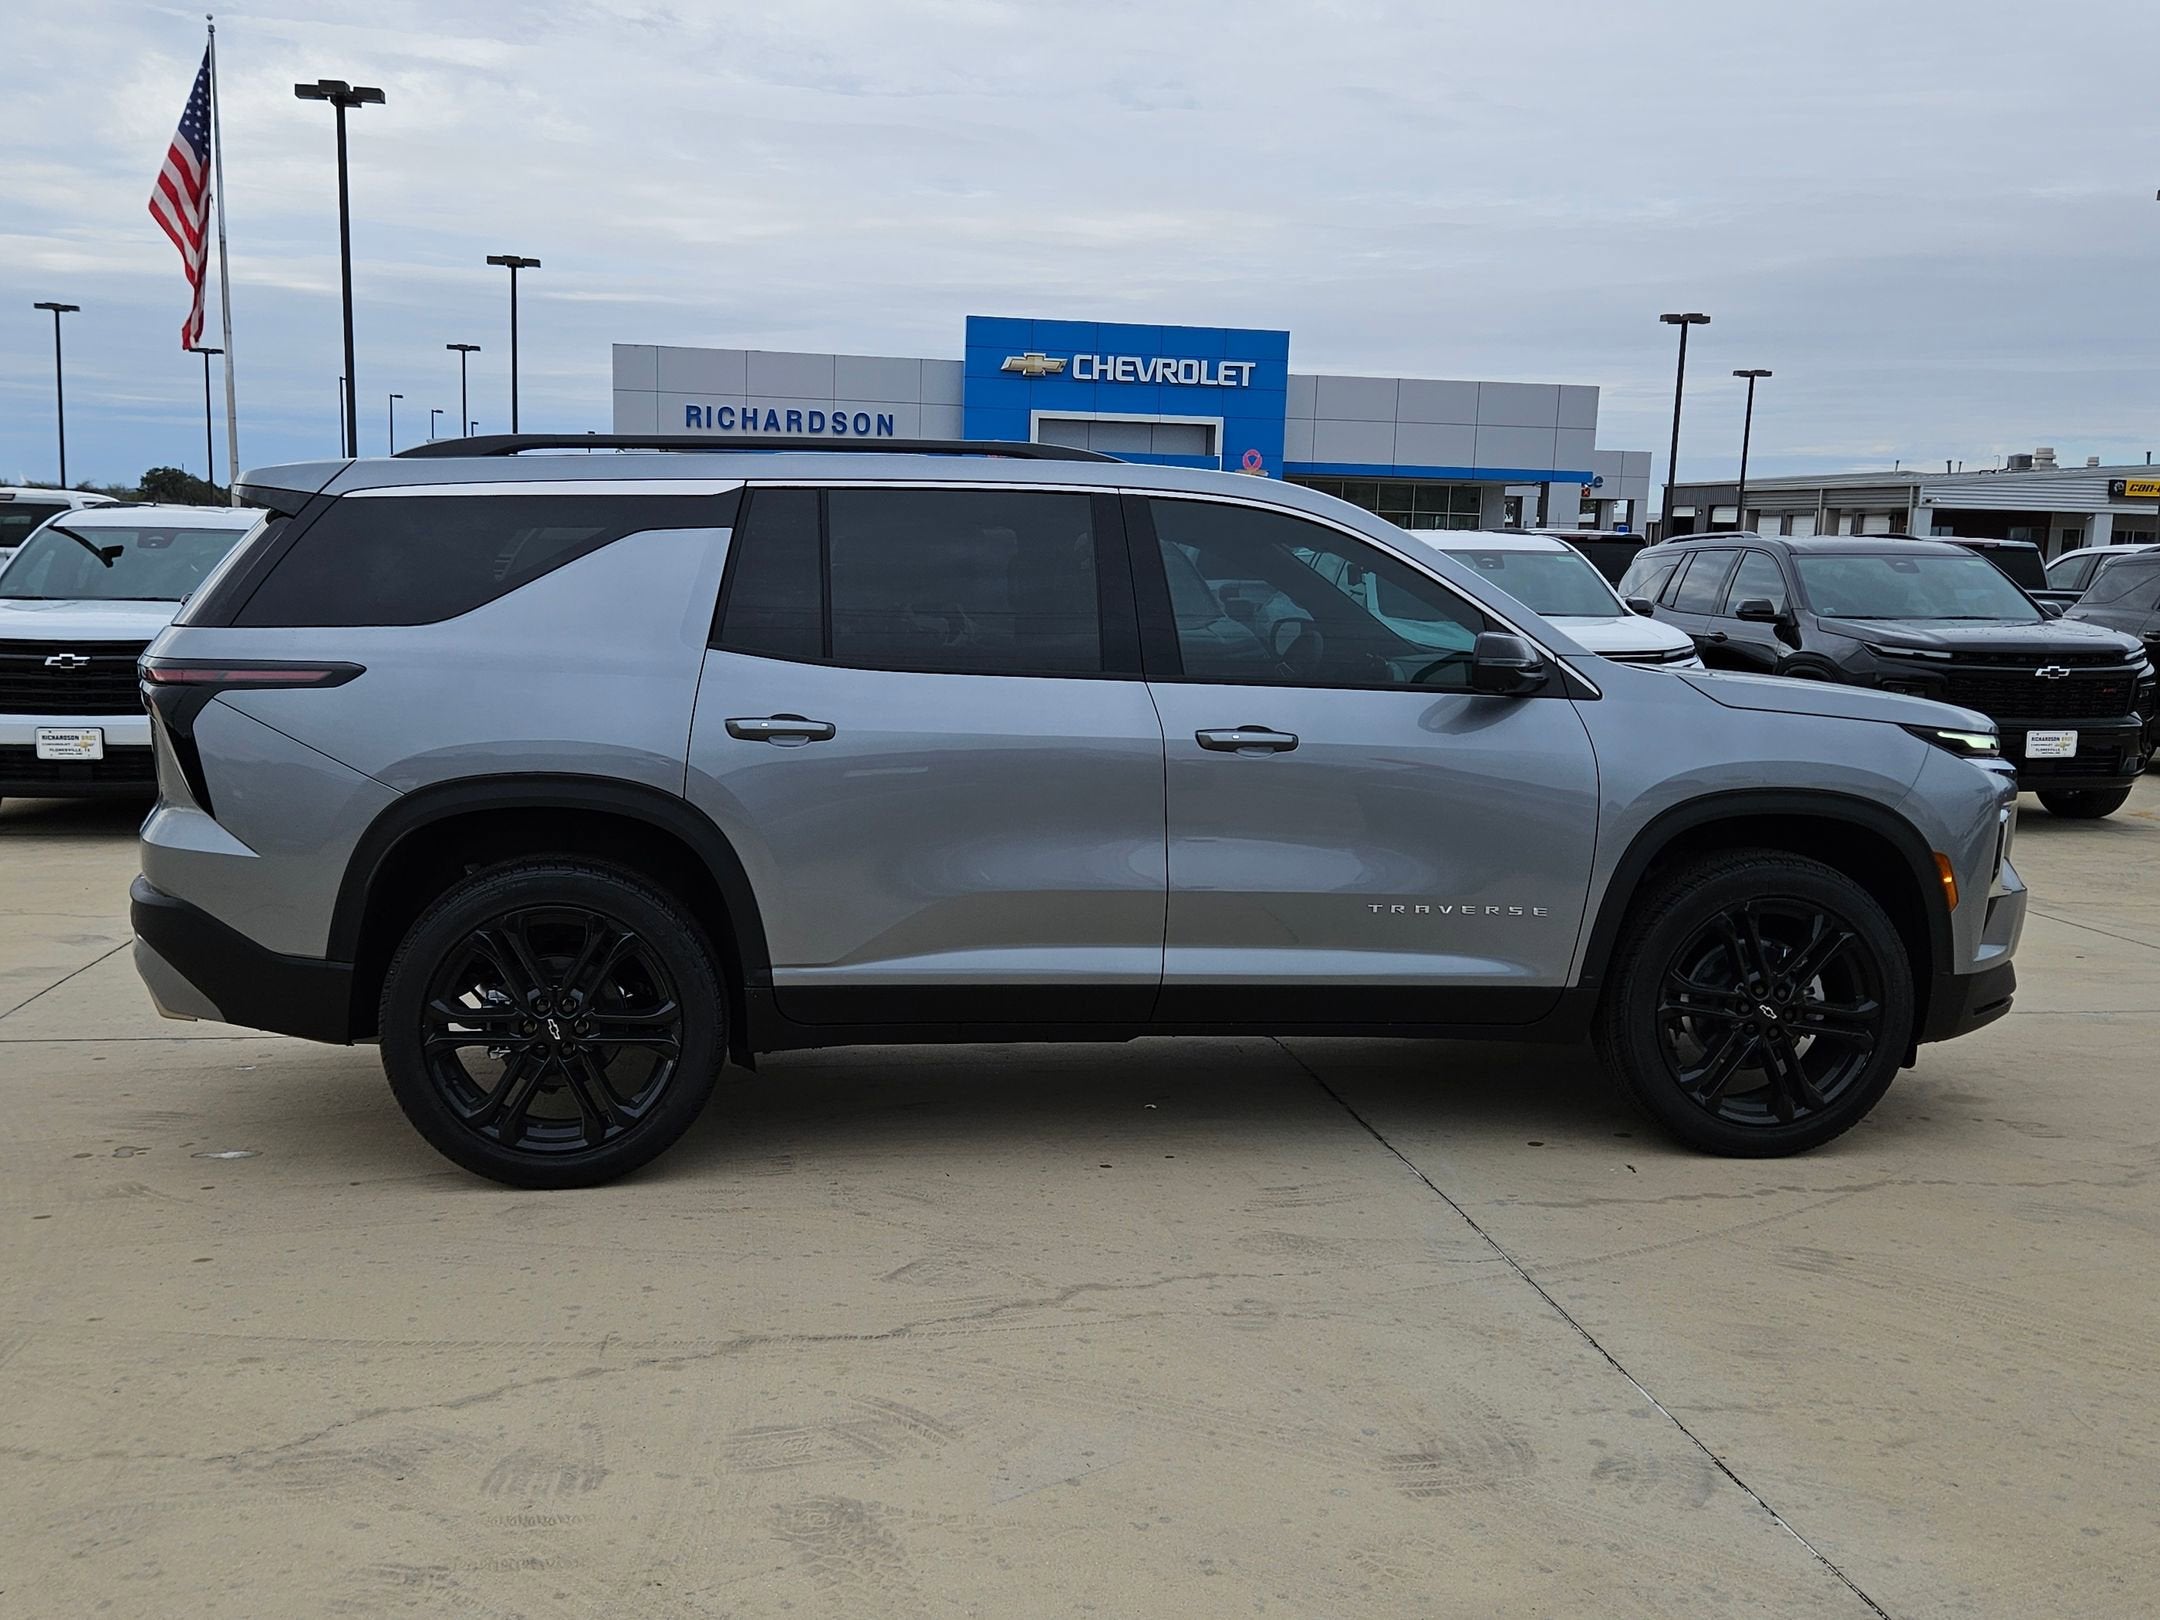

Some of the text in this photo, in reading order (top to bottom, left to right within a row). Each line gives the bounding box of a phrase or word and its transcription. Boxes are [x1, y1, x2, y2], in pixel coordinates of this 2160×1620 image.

[1072, 354, 1256, 387] CHEVROLET
[685, 404, 894, 437] RICHARDSON
[1368, 904, 1548, 917] TRAVERSE
